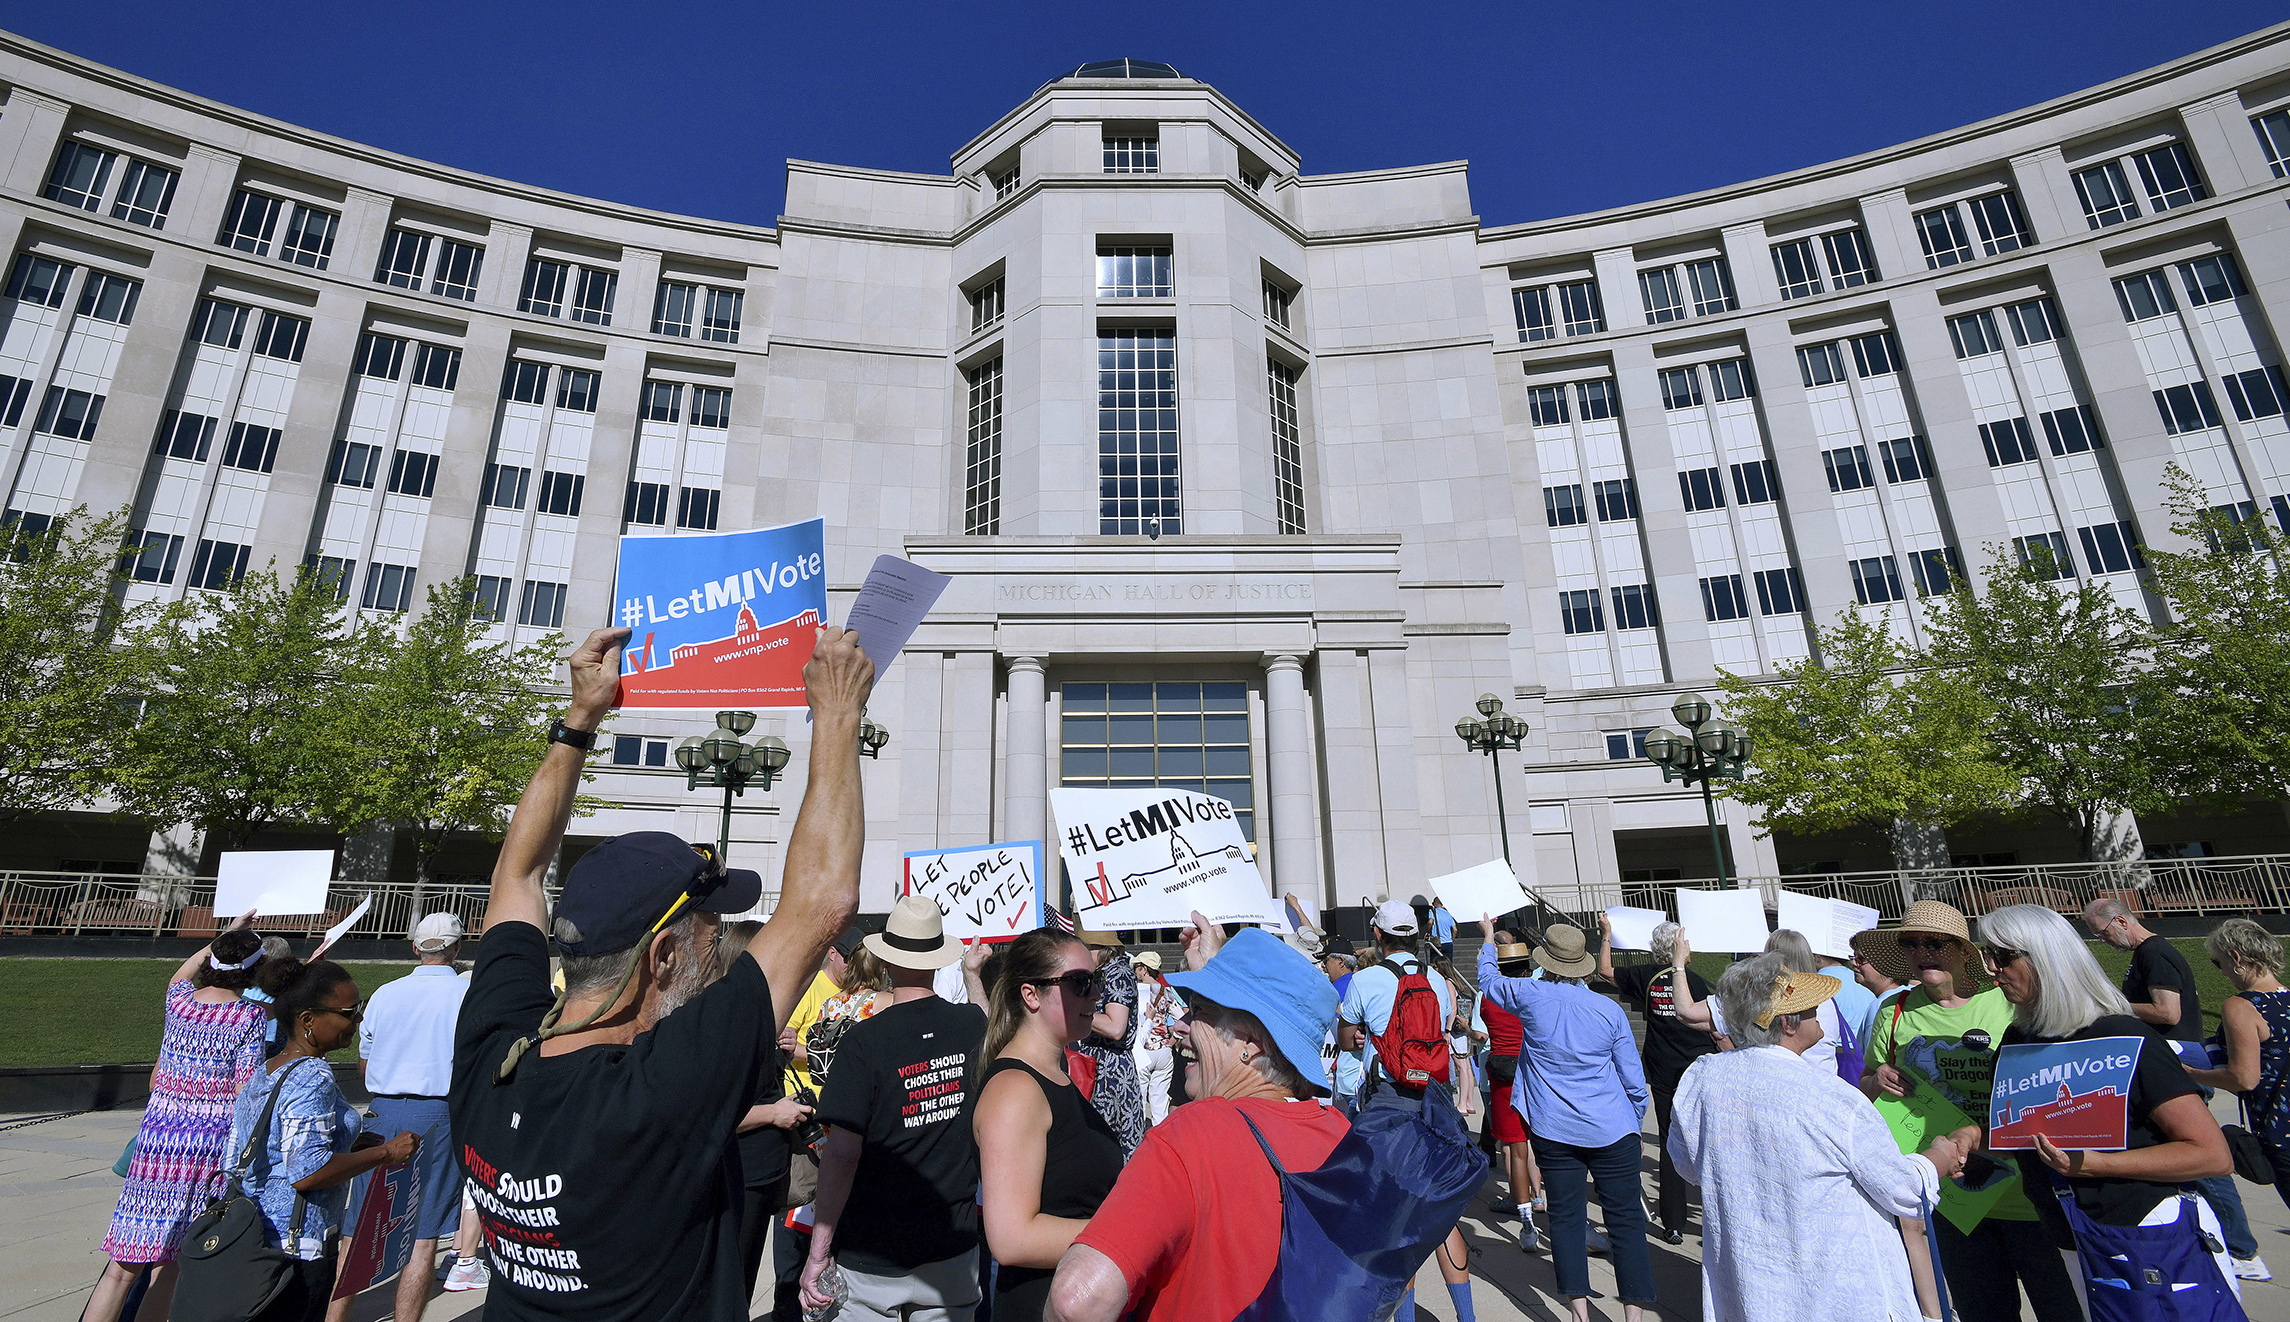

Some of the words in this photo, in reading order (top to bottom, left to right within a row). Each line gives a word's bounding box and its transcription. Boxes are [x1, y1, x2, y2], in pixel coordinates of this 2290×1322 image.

[621, 551, 822, 628] #LetMIVote
[999, 584, 1112, 600] MICHIGAN
[1124, 584, 1183, 600] HALL
[1189, 584, 1216, 600] OF
[1224, 583, 1312, 600] JUSTICE
[713, 636, 790, 665] www.vnp.vote
[1068, 796, 1232, 857] #LetMIVote
[912, 854, 949, 894] LET
[946, 850, 1013, 904] PEOPLE
[1163, 865, 1228, 894] www.vnp.vote
[966, 862, 1034, 926] VOTE!
[898, 1061, 929, 1078] VOTERS
[930, 1053, 966, 1070] SHOULD
[1940, 1057, 1966, 1069] Slay
[1996, 1054, 2131, 1099] #LetMIVote
[904, 1072, 939, 1090] CHOOSE
[939, 1067, 964, 1081] THEIR
[909, 1080, 960, 1101] POLITICIANS
[902, 1103, 919, 1116] NOT
[920, 1099, 938, 1112] THE
[939, 1092, 965, 1107] OTHER
[2045, 1101, 2093, 1120] www.vnp.vote
[904, 1115, 925, 1128] WAY
[464, 1144, 498, 1189] VOTERS
[508, 1206, 560, 1228] THEIR
[497, 1235, 525, 1263] THE
[526, 1246, 581, 1270] OTHER
[512, 1263, 589, 1293] AROUND.
